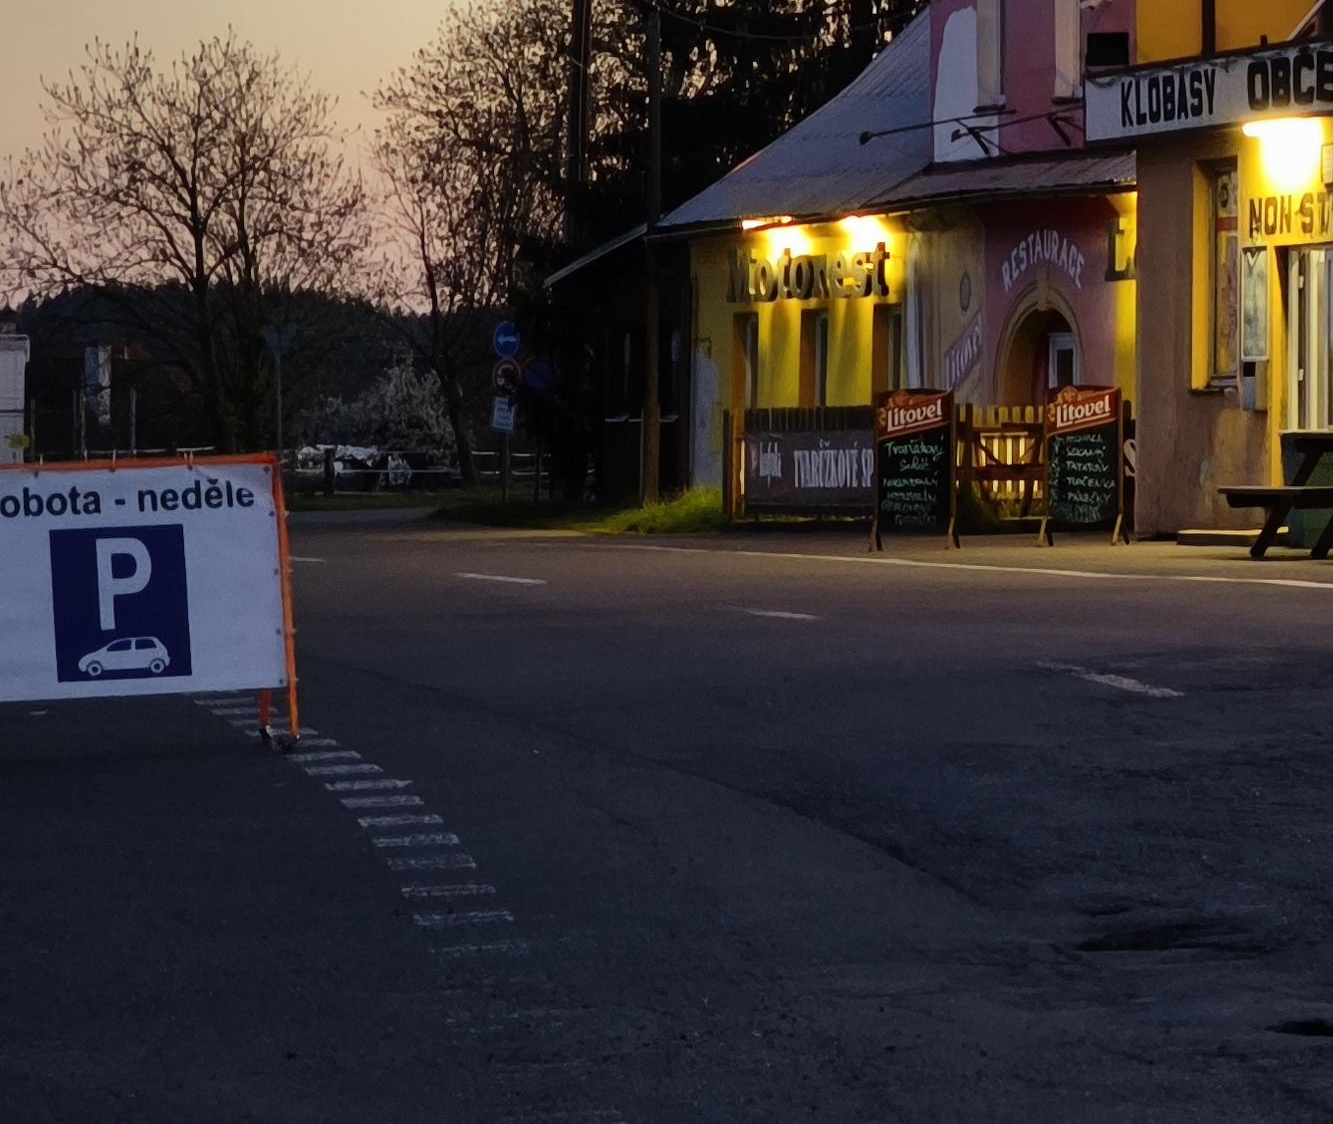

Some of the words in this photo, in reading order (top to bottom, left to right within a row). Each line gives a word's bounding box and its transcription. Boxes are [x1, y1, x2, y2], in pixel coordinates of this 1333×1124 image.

[1121, 66, 1216, 128] KLOBÁSY
[1001, 228, 1084, 292] RESTAURACE
[887, 398, 942, 432] Litovel
[1056, 395, 1111, 428] Litovel
[138, 479, 255, 512] neděle
[96, 537, 152, 631] P
